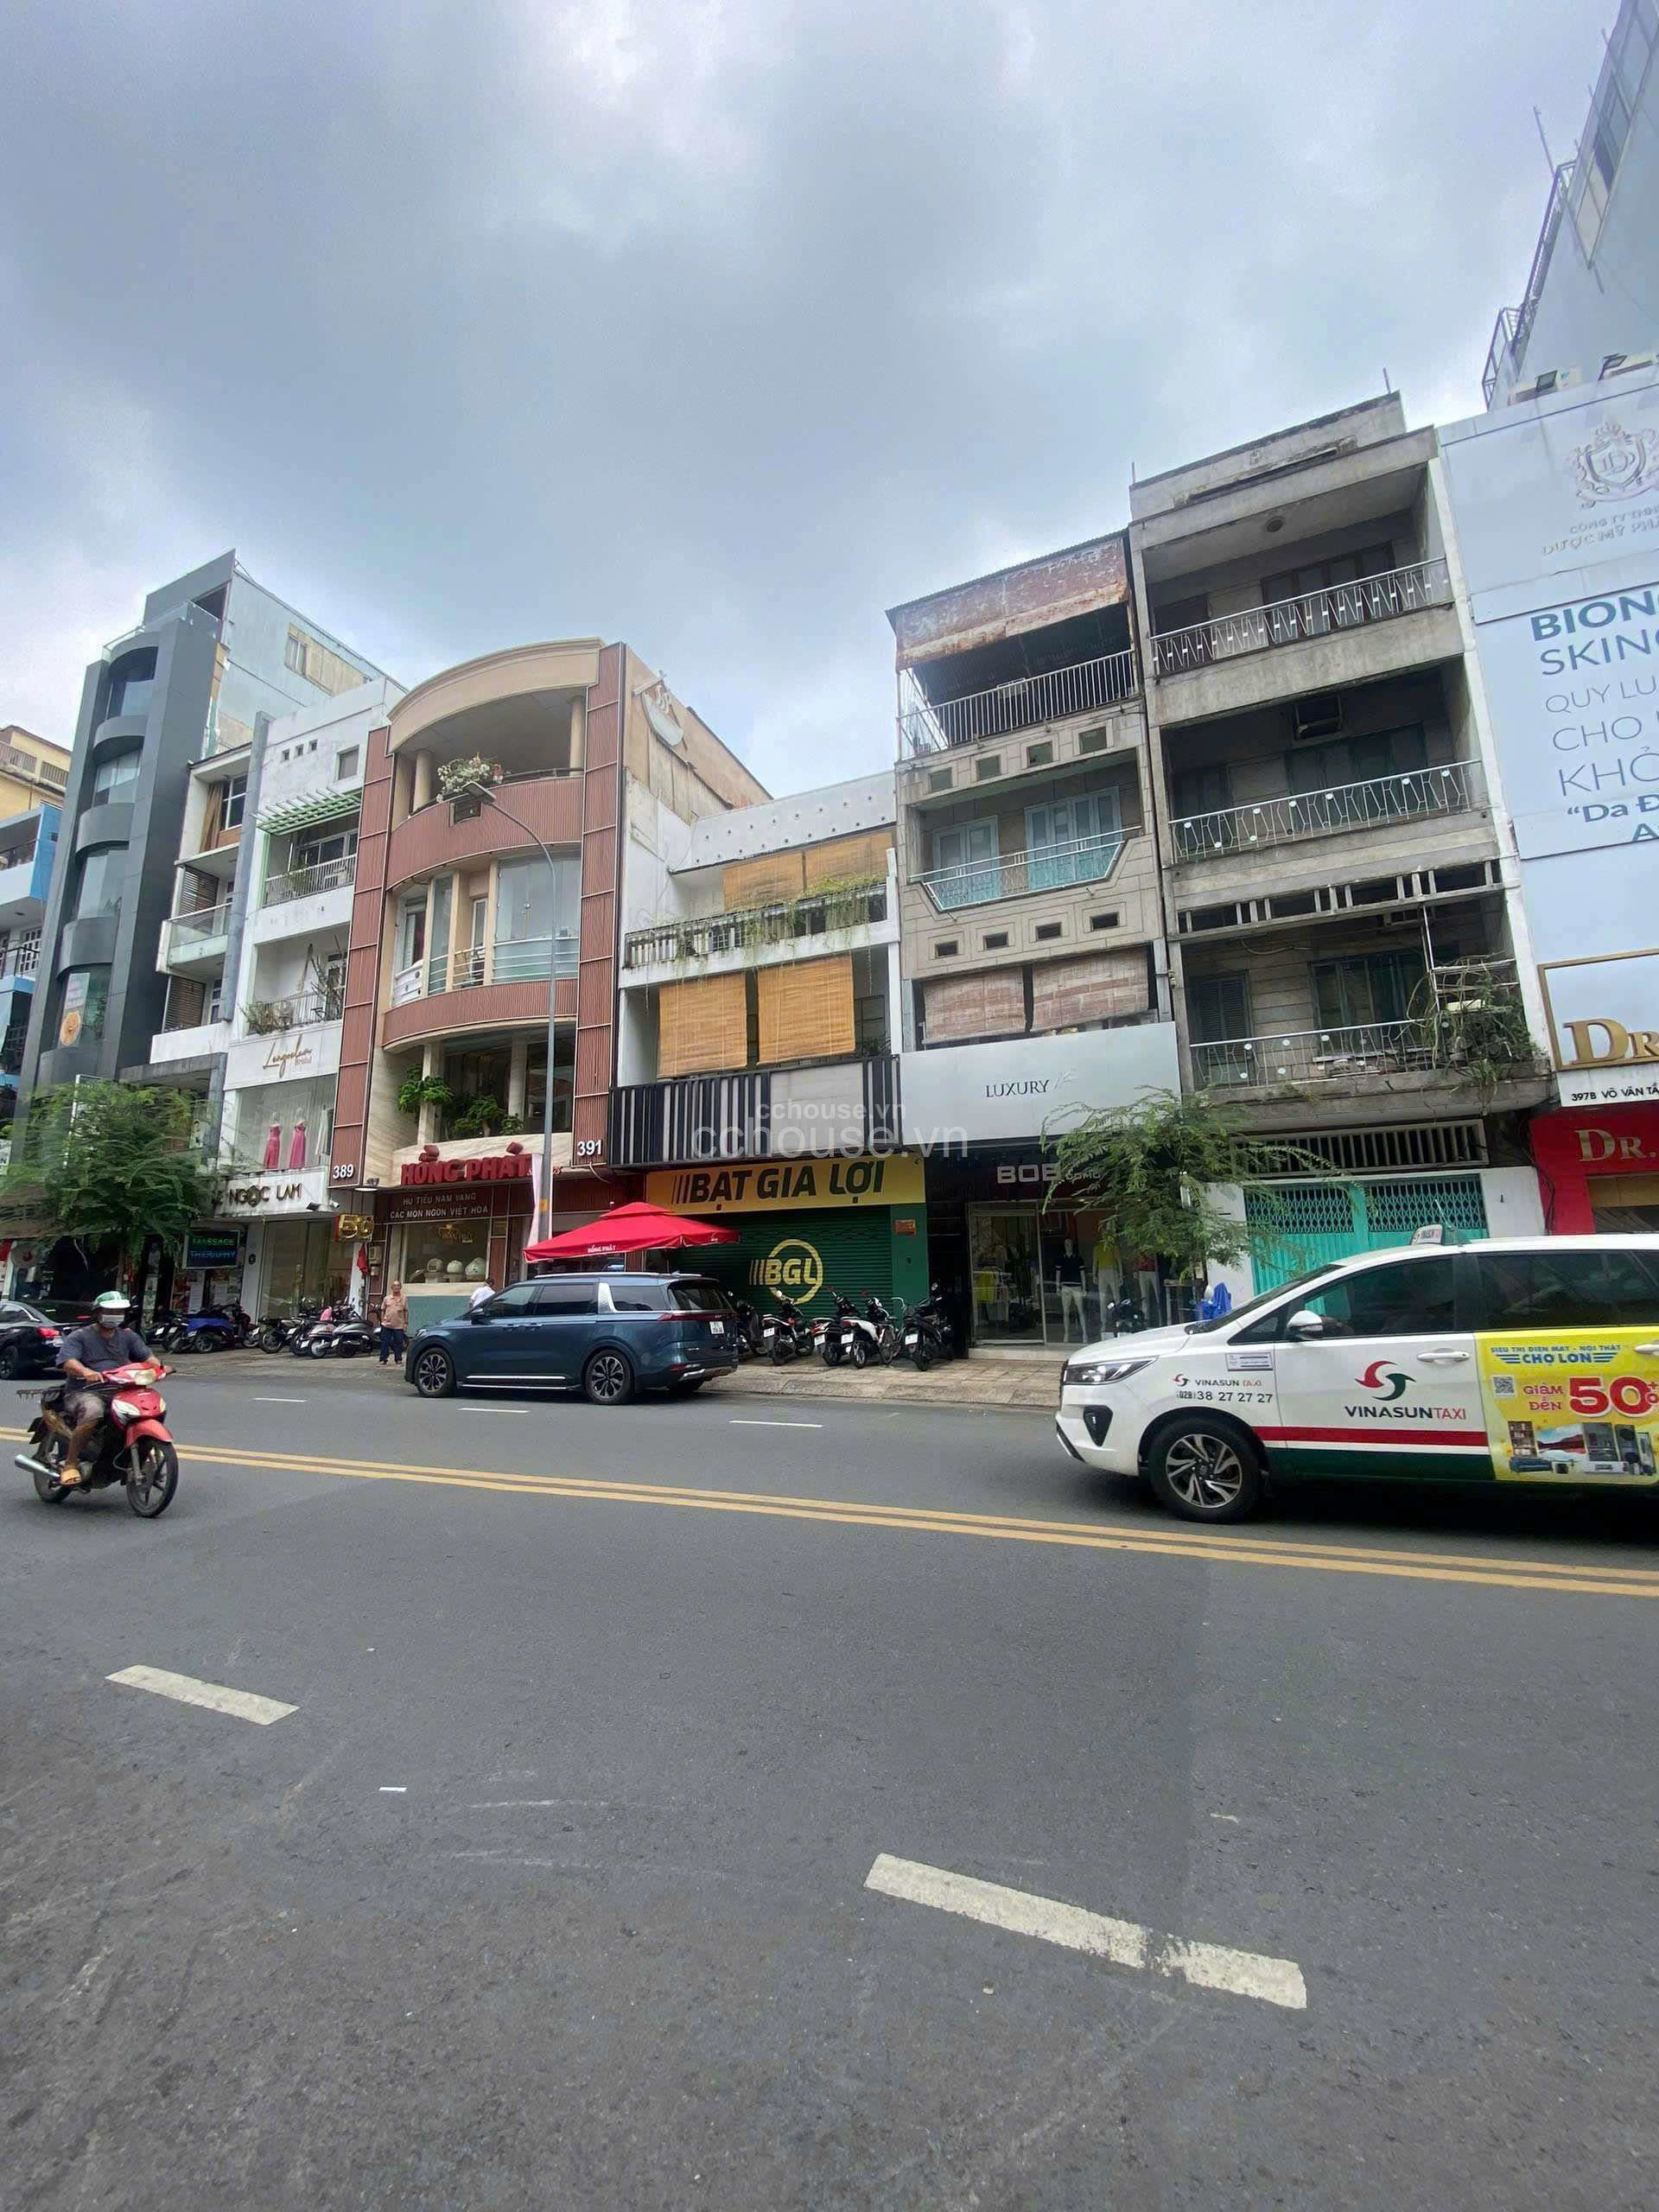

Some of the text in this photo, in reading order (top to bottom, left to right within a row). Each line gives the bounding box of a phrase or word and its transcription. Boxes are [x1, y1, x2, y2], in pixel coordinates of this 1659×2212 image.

[1530, 590, 1659, 641] BION
[1540, 629, 1659, 675] SKIN
[1545, 676, 1659, 713] QUY LU
[1553, 716, 1642, 751] CHO
[986, 1079, 1050, 1097] LUXURY
[1571, 1092, 1596, 1102] 397B
[576, 1139, 602, 1156] 391
[333, 1164, 354, 1179] 389
[690, 1160, 886, 1211] BẠT GIA LỢI
[766, 1258, 817, 1286] BGL
[1218, 1392, 1233, 1401] 27
[1237, 1393, 1252, 1402] 27
[1257, 1394, 1273, 1402] 27
